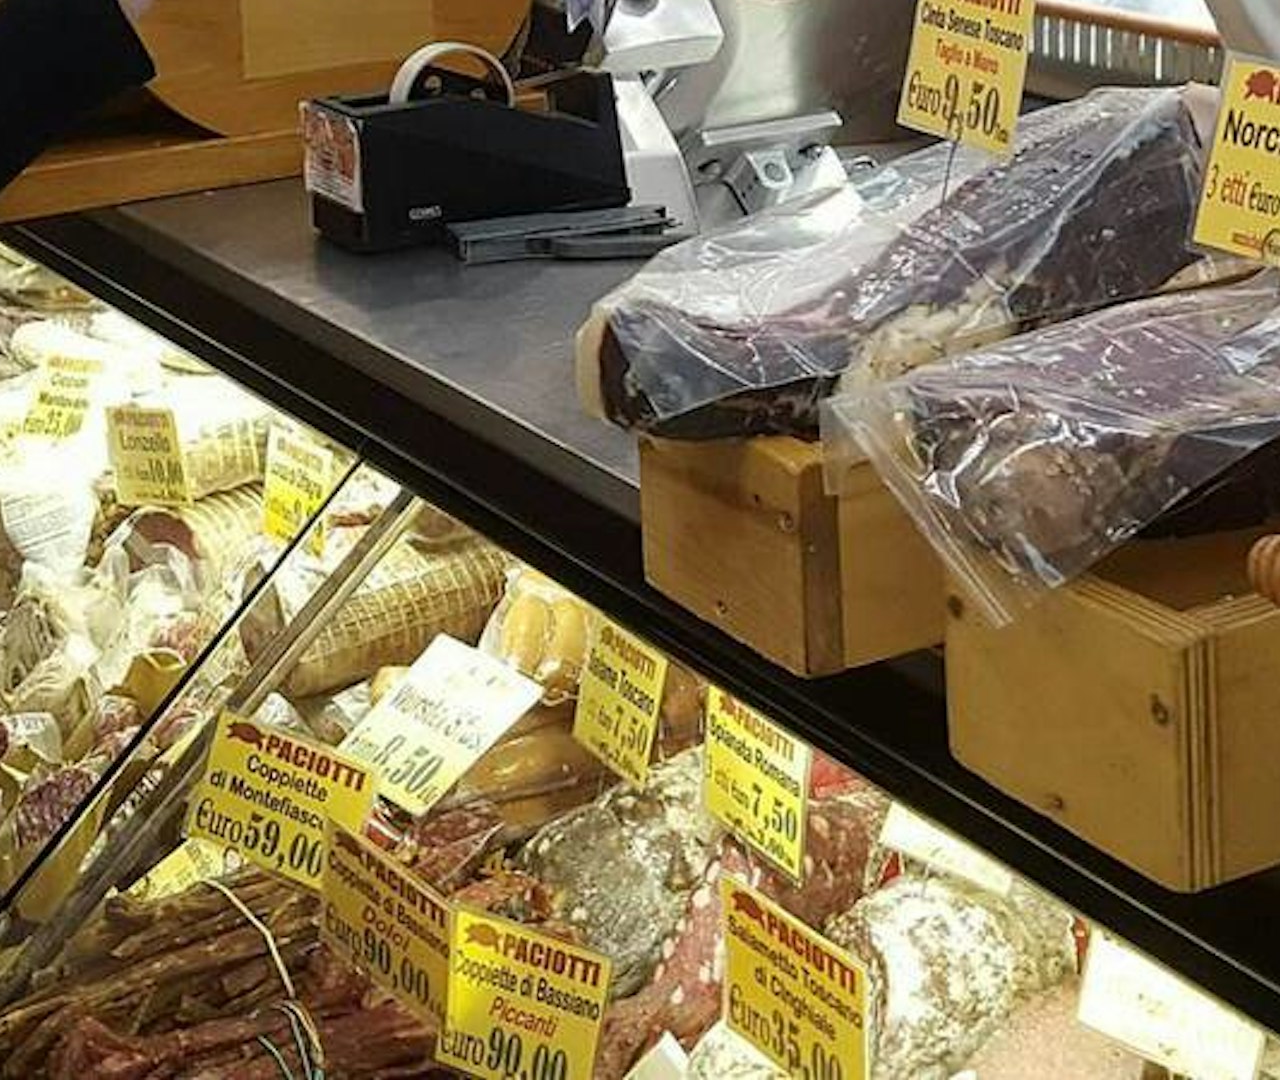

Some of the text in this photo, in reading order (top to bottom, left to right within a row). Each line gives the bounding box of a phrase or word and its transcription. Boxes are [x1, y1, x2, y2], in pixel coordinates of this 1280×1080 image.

[948, 8, 981, 39] Senese
[984, 18, 1024, 51] Toscano
[1206, 164, 1220, 200] 3
[1221, 171, 1250, 207] etti
[210, 771, 227, 790] di
[246, 753, 329, 802] Coppiette
[265, 734, 366, 792] PACIOTTI
[754, 749, 801, 798] Romana
[751, 782, 799, 842] 7,50
[363, 906, 411, 952] Dolci
[766, 911, 856, 995] PACIOTTI
[502, 932, 603, 988] PACIOTTI
[488, 995, 559, 1039] Piccanti
[520, 974, 533, 997] di
[535, 976, 601, 1021] Bassiano
